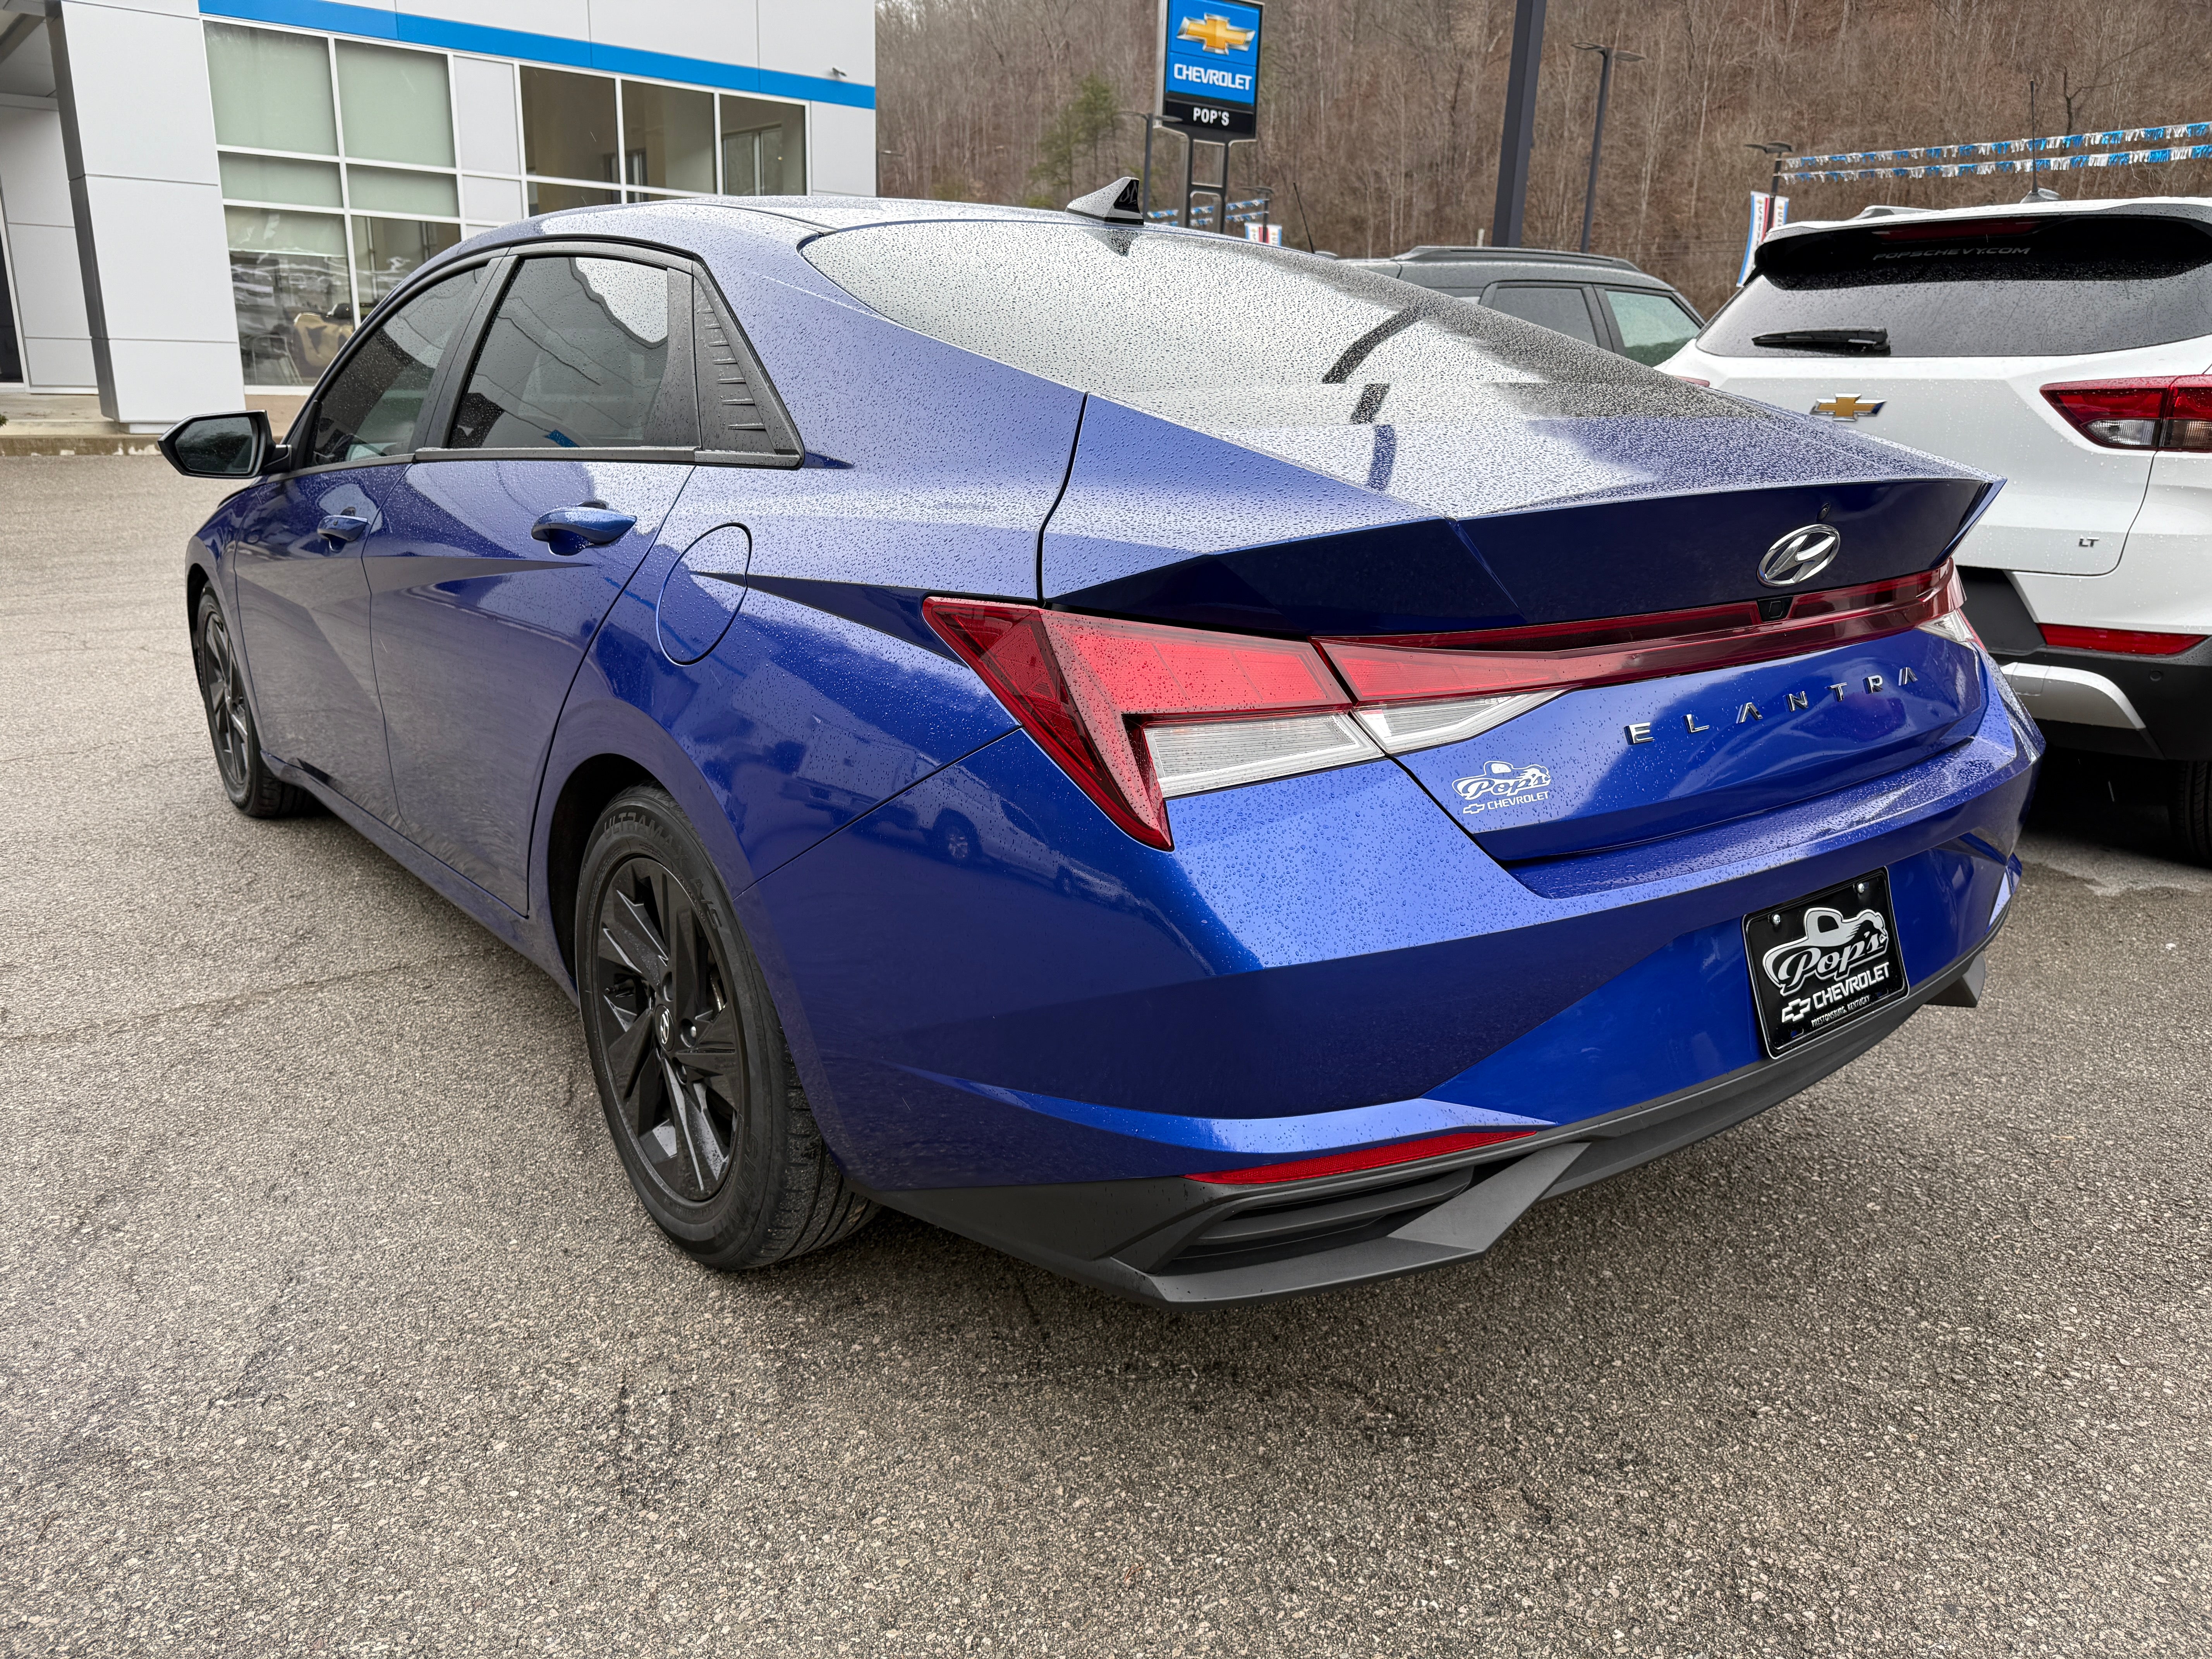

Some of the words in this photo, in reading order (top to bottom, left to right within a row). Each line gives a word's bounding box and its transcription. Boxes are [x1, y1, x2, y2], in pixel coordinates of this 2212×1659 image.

[1174, 63, 1252, 91] CHEVROLET
[1193, 107, 1230, 126] POP'S
[1873, 247, 2031, 261] POPSCHEVY.COM
[2078, 535, 2100, 548] LT
[1624, 666, 1918, 745] ELANTRA
[1462, 773, 1548, 798] Pop's
[1487, 791, 1549, 810] CHEVROLET
[1778, 931, 1884, 988] Pop's
[1812, 962, 1889, 1009] CHEVROLET
[1847, 994, 1871, 1011] KENTUCKY
